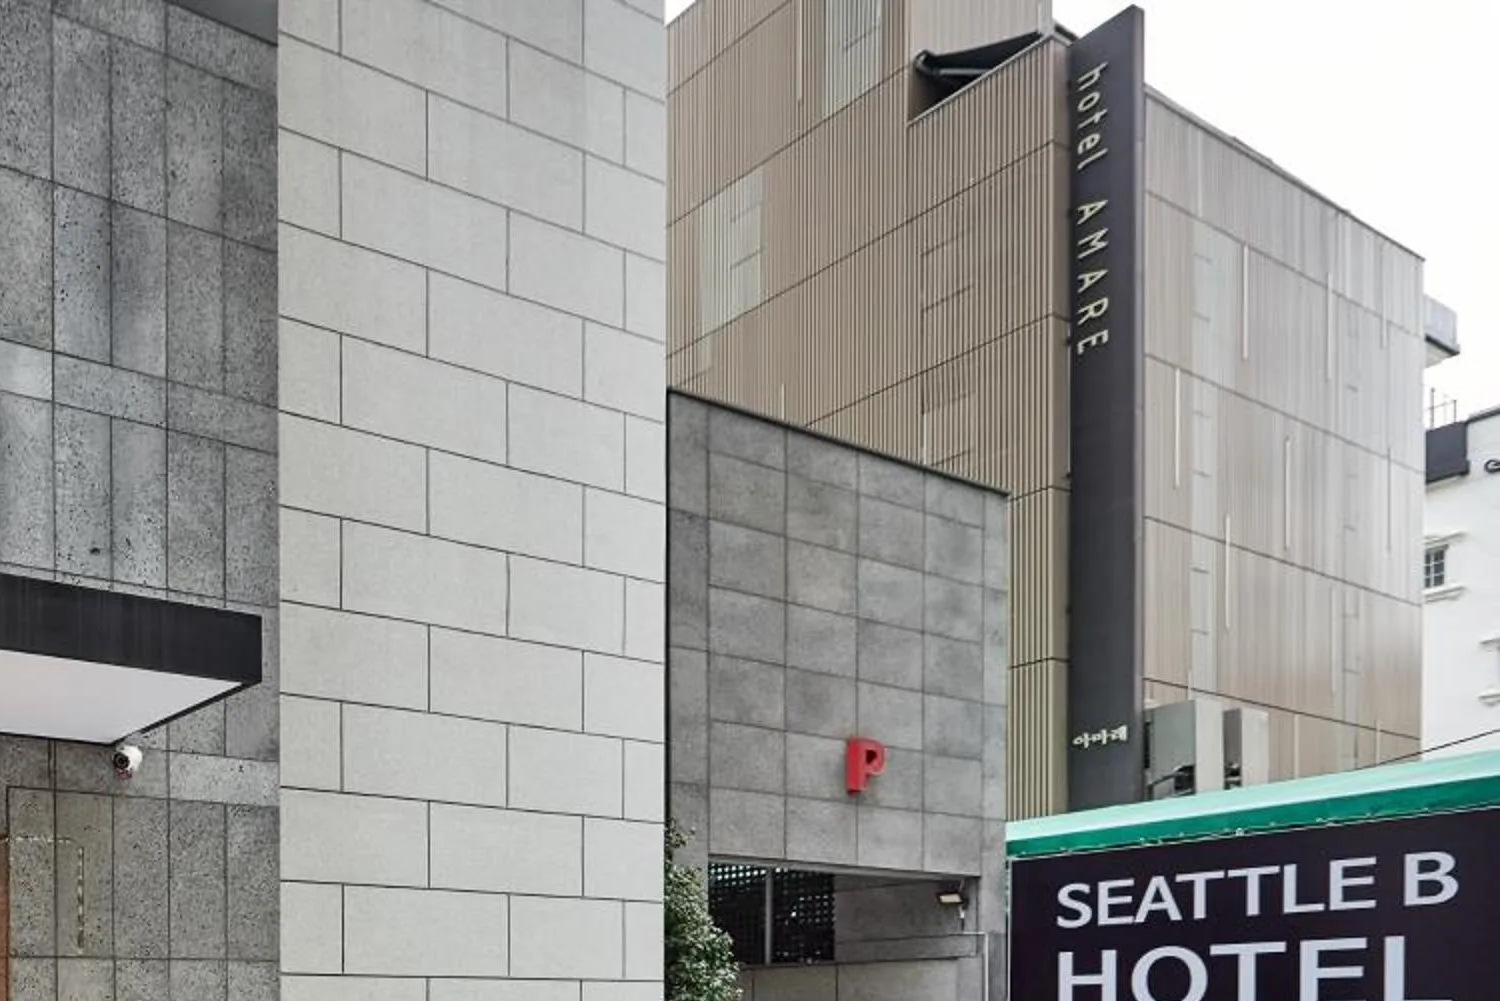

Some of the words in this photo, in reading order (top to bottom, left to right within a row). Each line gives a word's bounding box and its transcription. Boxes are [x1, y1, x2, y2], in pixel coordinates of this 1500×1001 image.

[1077, 61, 1109, 171] hotel
[1076, 199, 1109, 355] AMARE
[847, 737, 886, 794] P
[1056, 856, 1377, 928] SEATTLE
[1404, 851, 1459, 906] B
